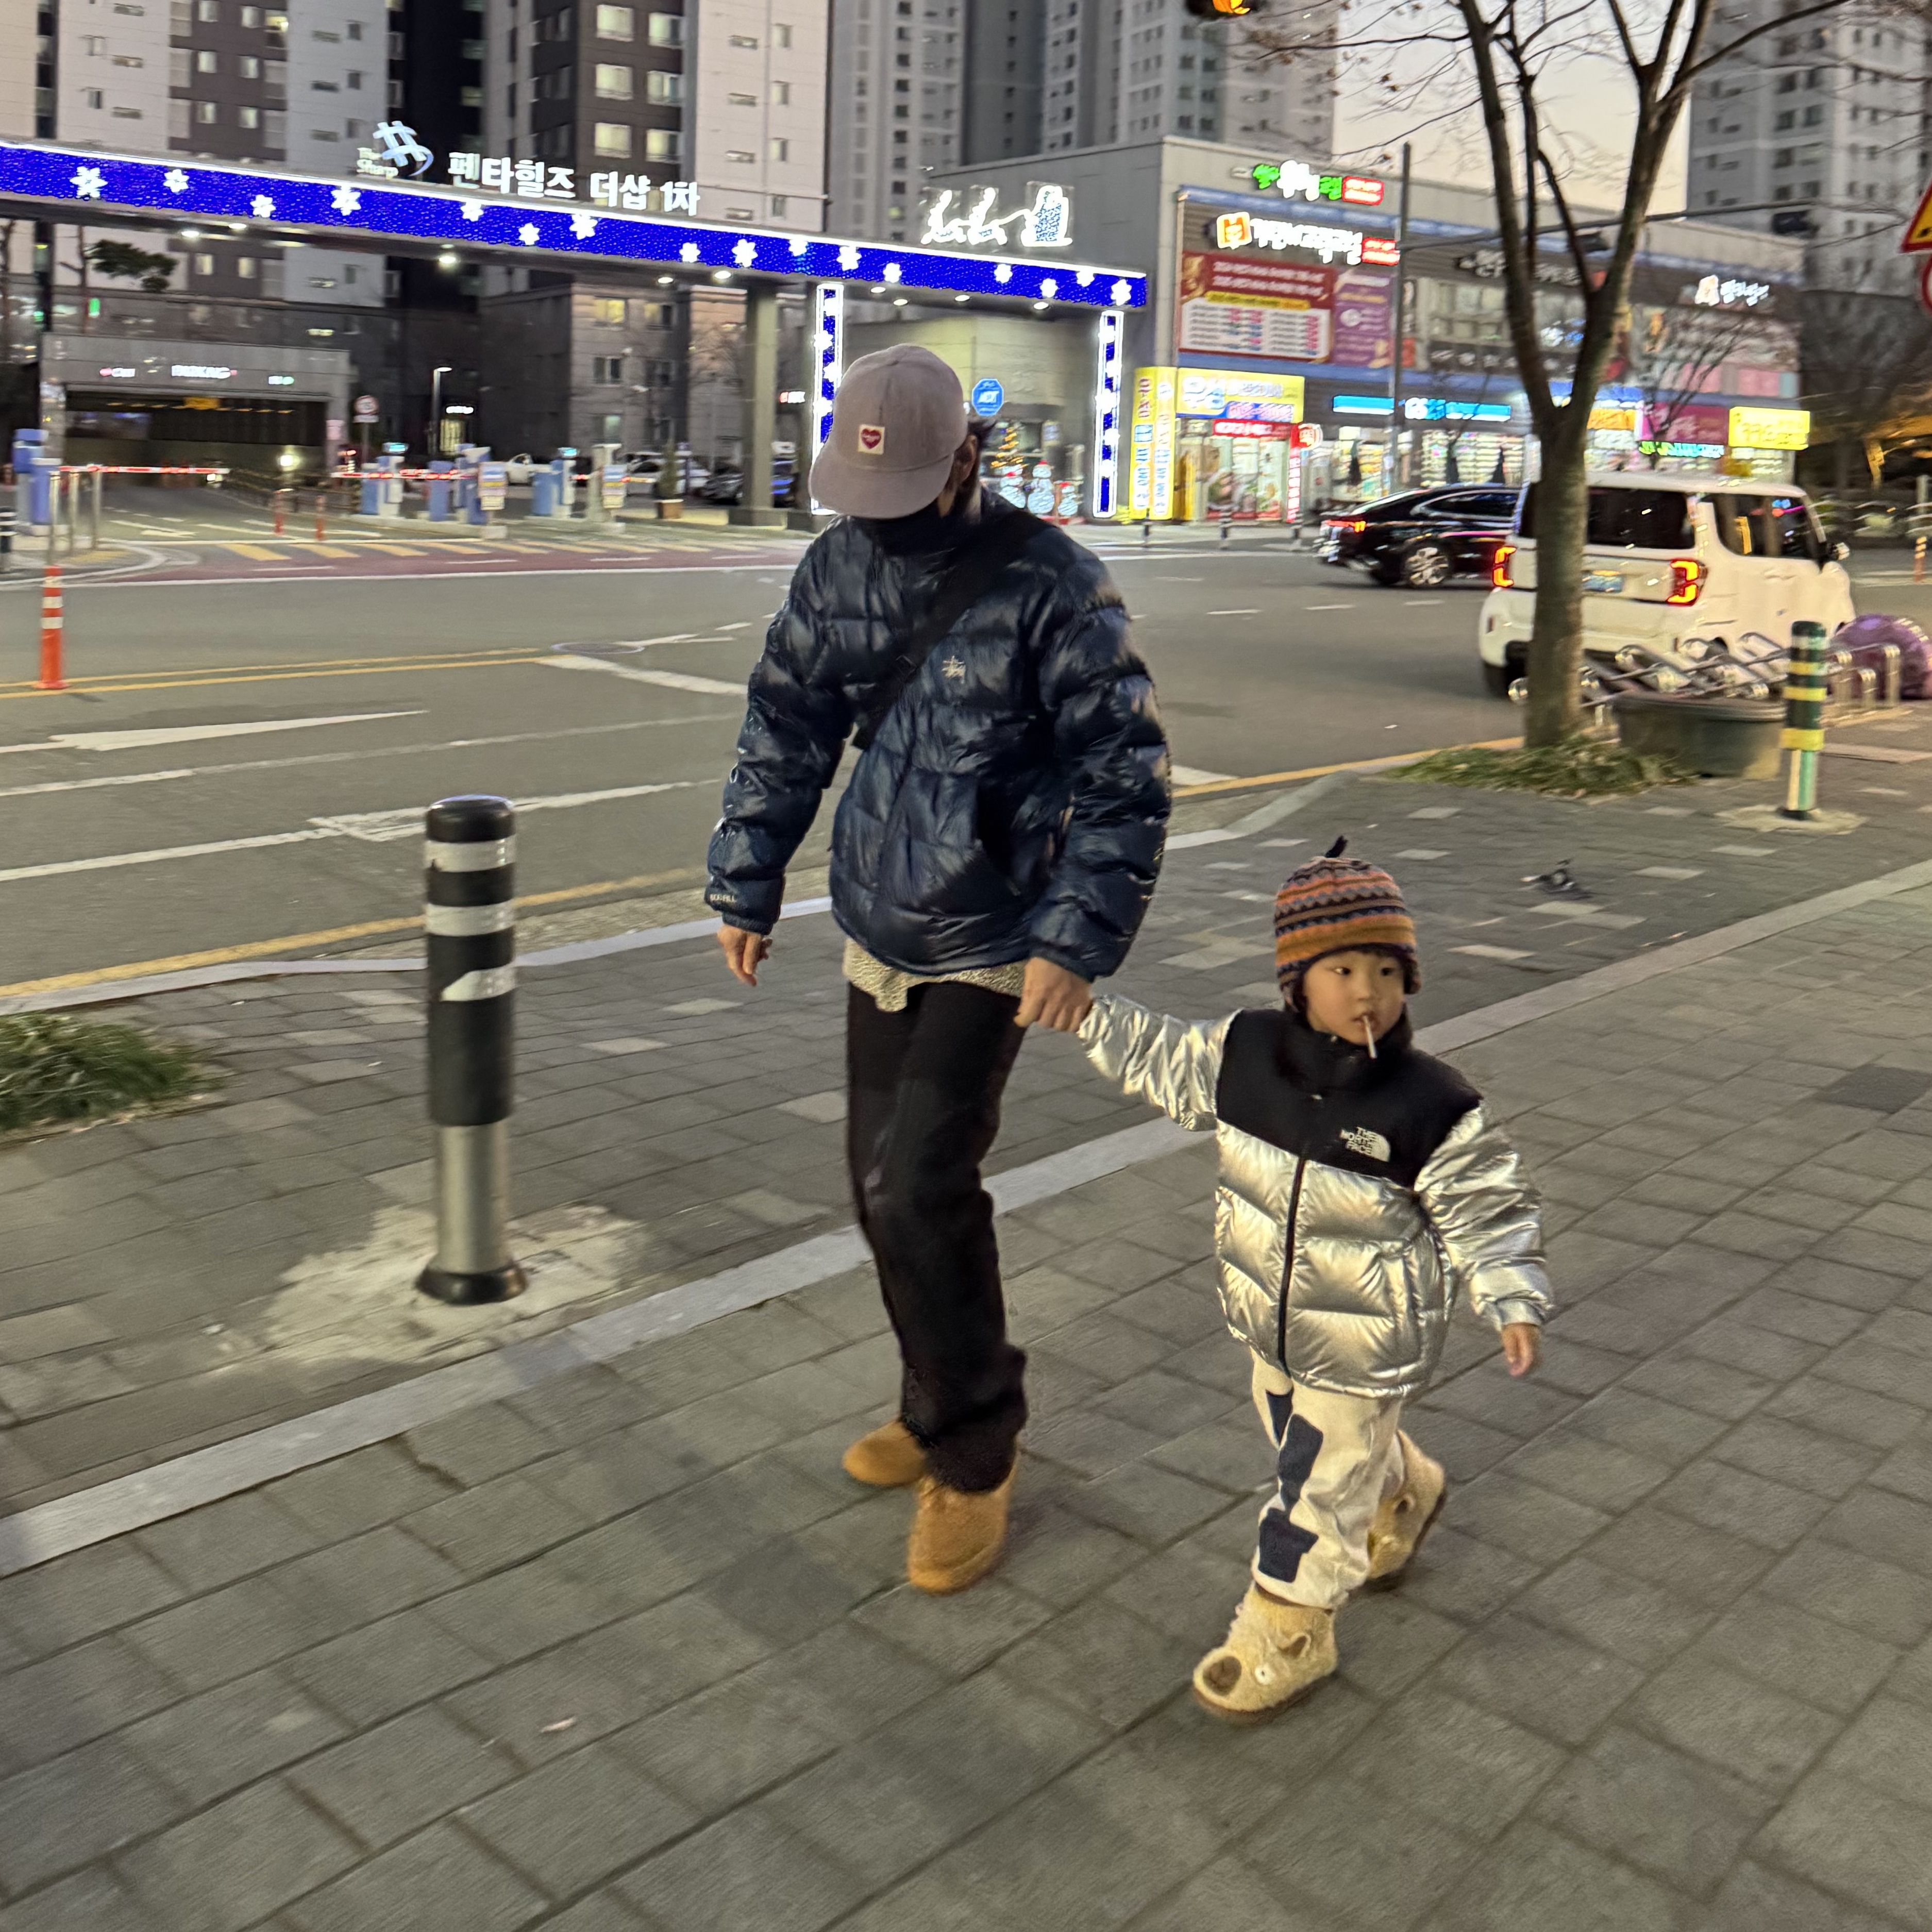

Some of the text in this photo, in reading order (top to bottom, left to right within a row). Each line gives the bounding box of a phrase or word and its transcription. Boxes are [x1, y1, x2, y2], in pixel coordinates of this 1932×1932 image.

[448, 152, 700, 216] 펜타힐즈 더샵 1차
